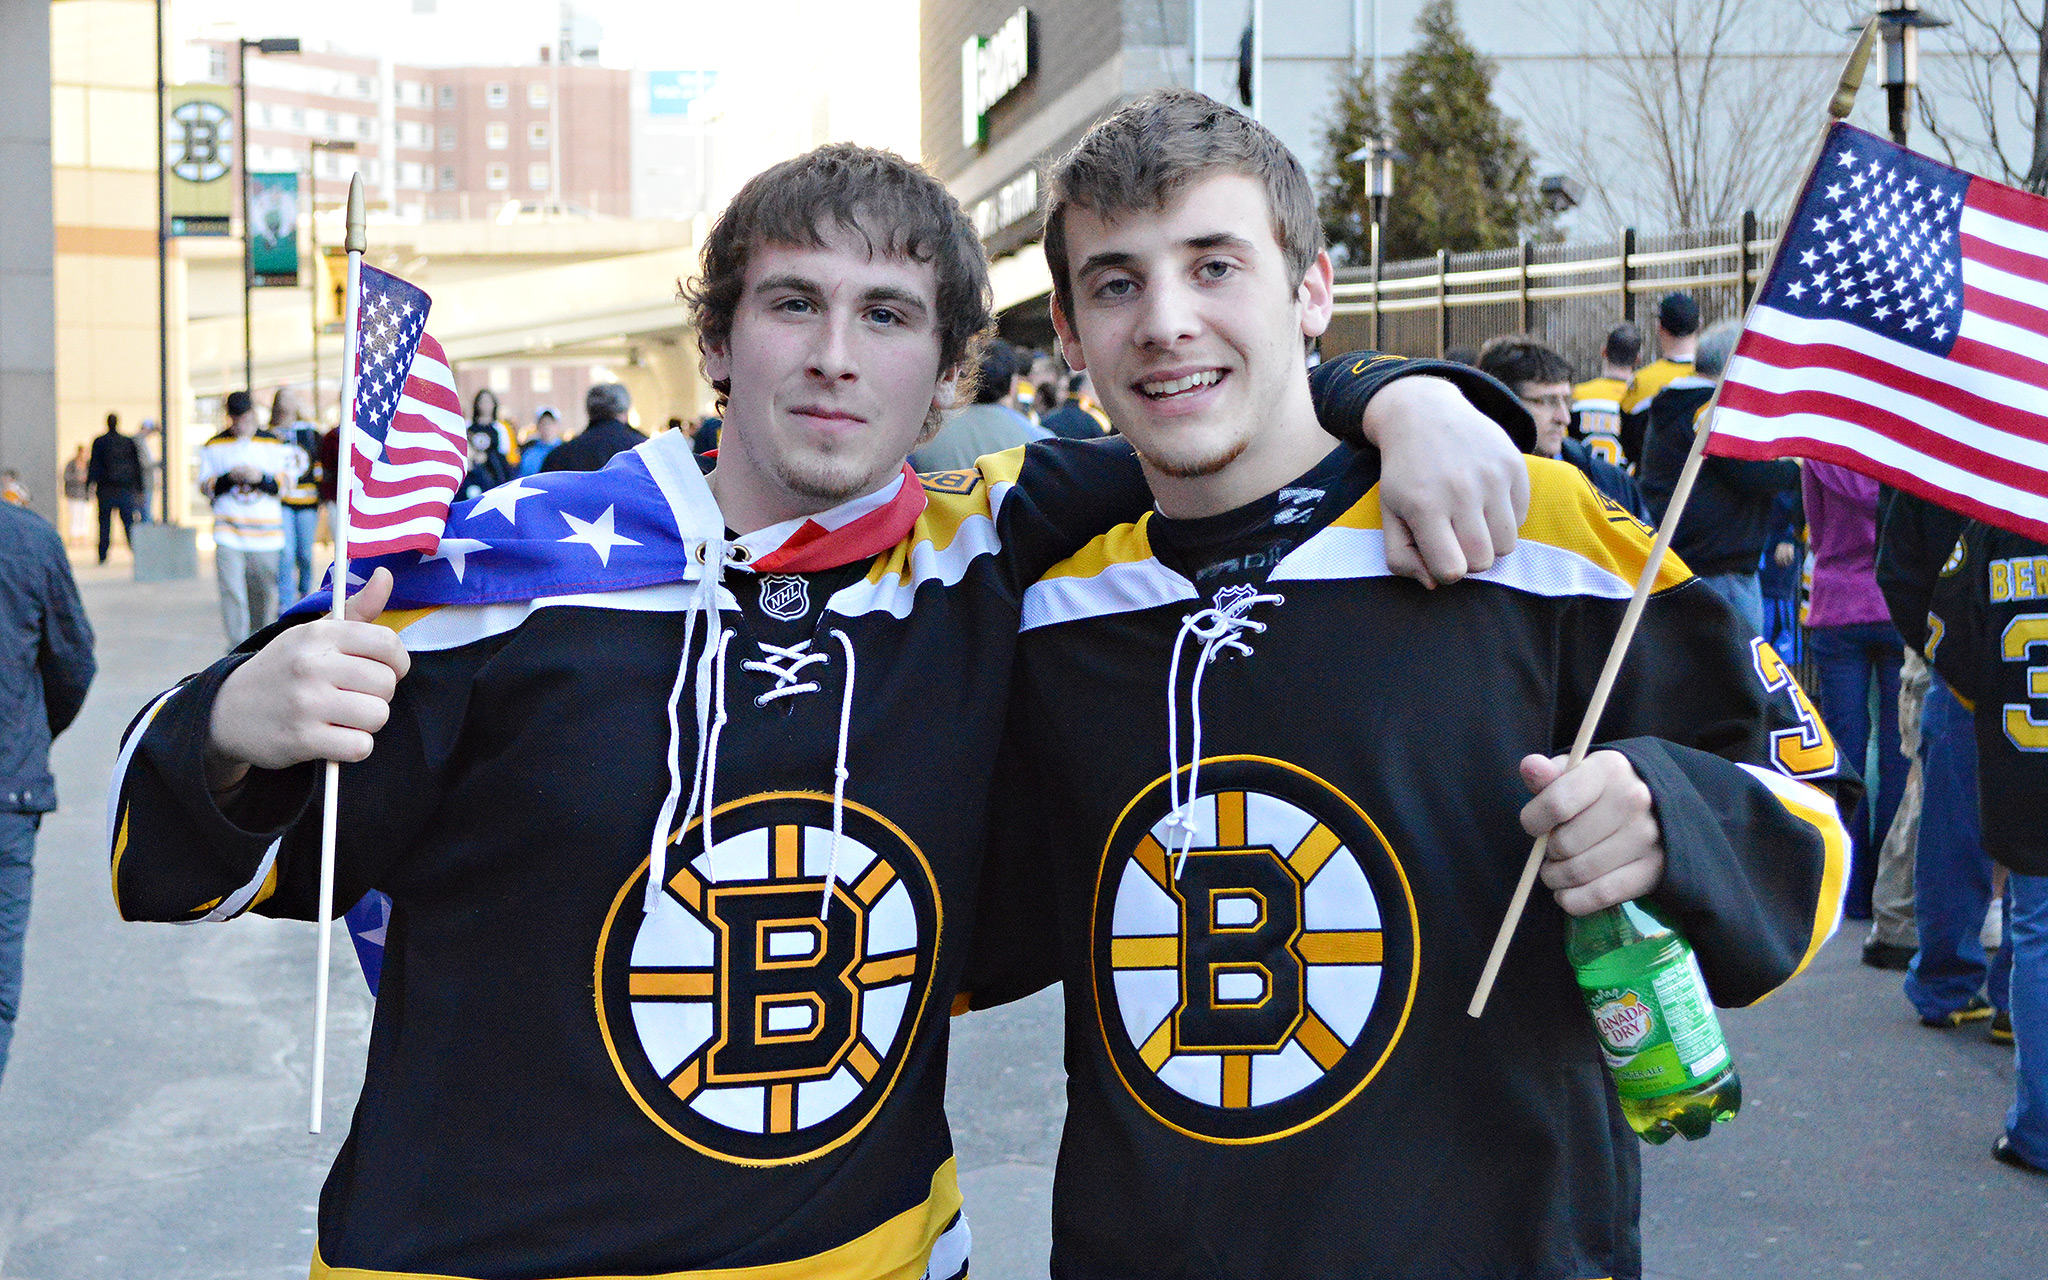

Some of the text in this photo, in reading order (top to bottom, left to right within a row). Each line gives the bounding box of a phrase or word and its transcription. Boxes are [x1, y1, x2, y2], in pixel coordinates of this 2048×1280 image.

[183, 120, 217, 163] B
[770, 585, 799, 609] NHL
[2001, 612, 2048, 753] 3
[1750, 635, 1839, 780] 3
[1168, 847, 1305, 1053] B
[704, 881, 865, 1084] B
[1595, 1002, 1651, 1036] CANADA
[1611, 1020, 1640, 1043] DRY
[1646, 1065, 1663, 1076] ALE
